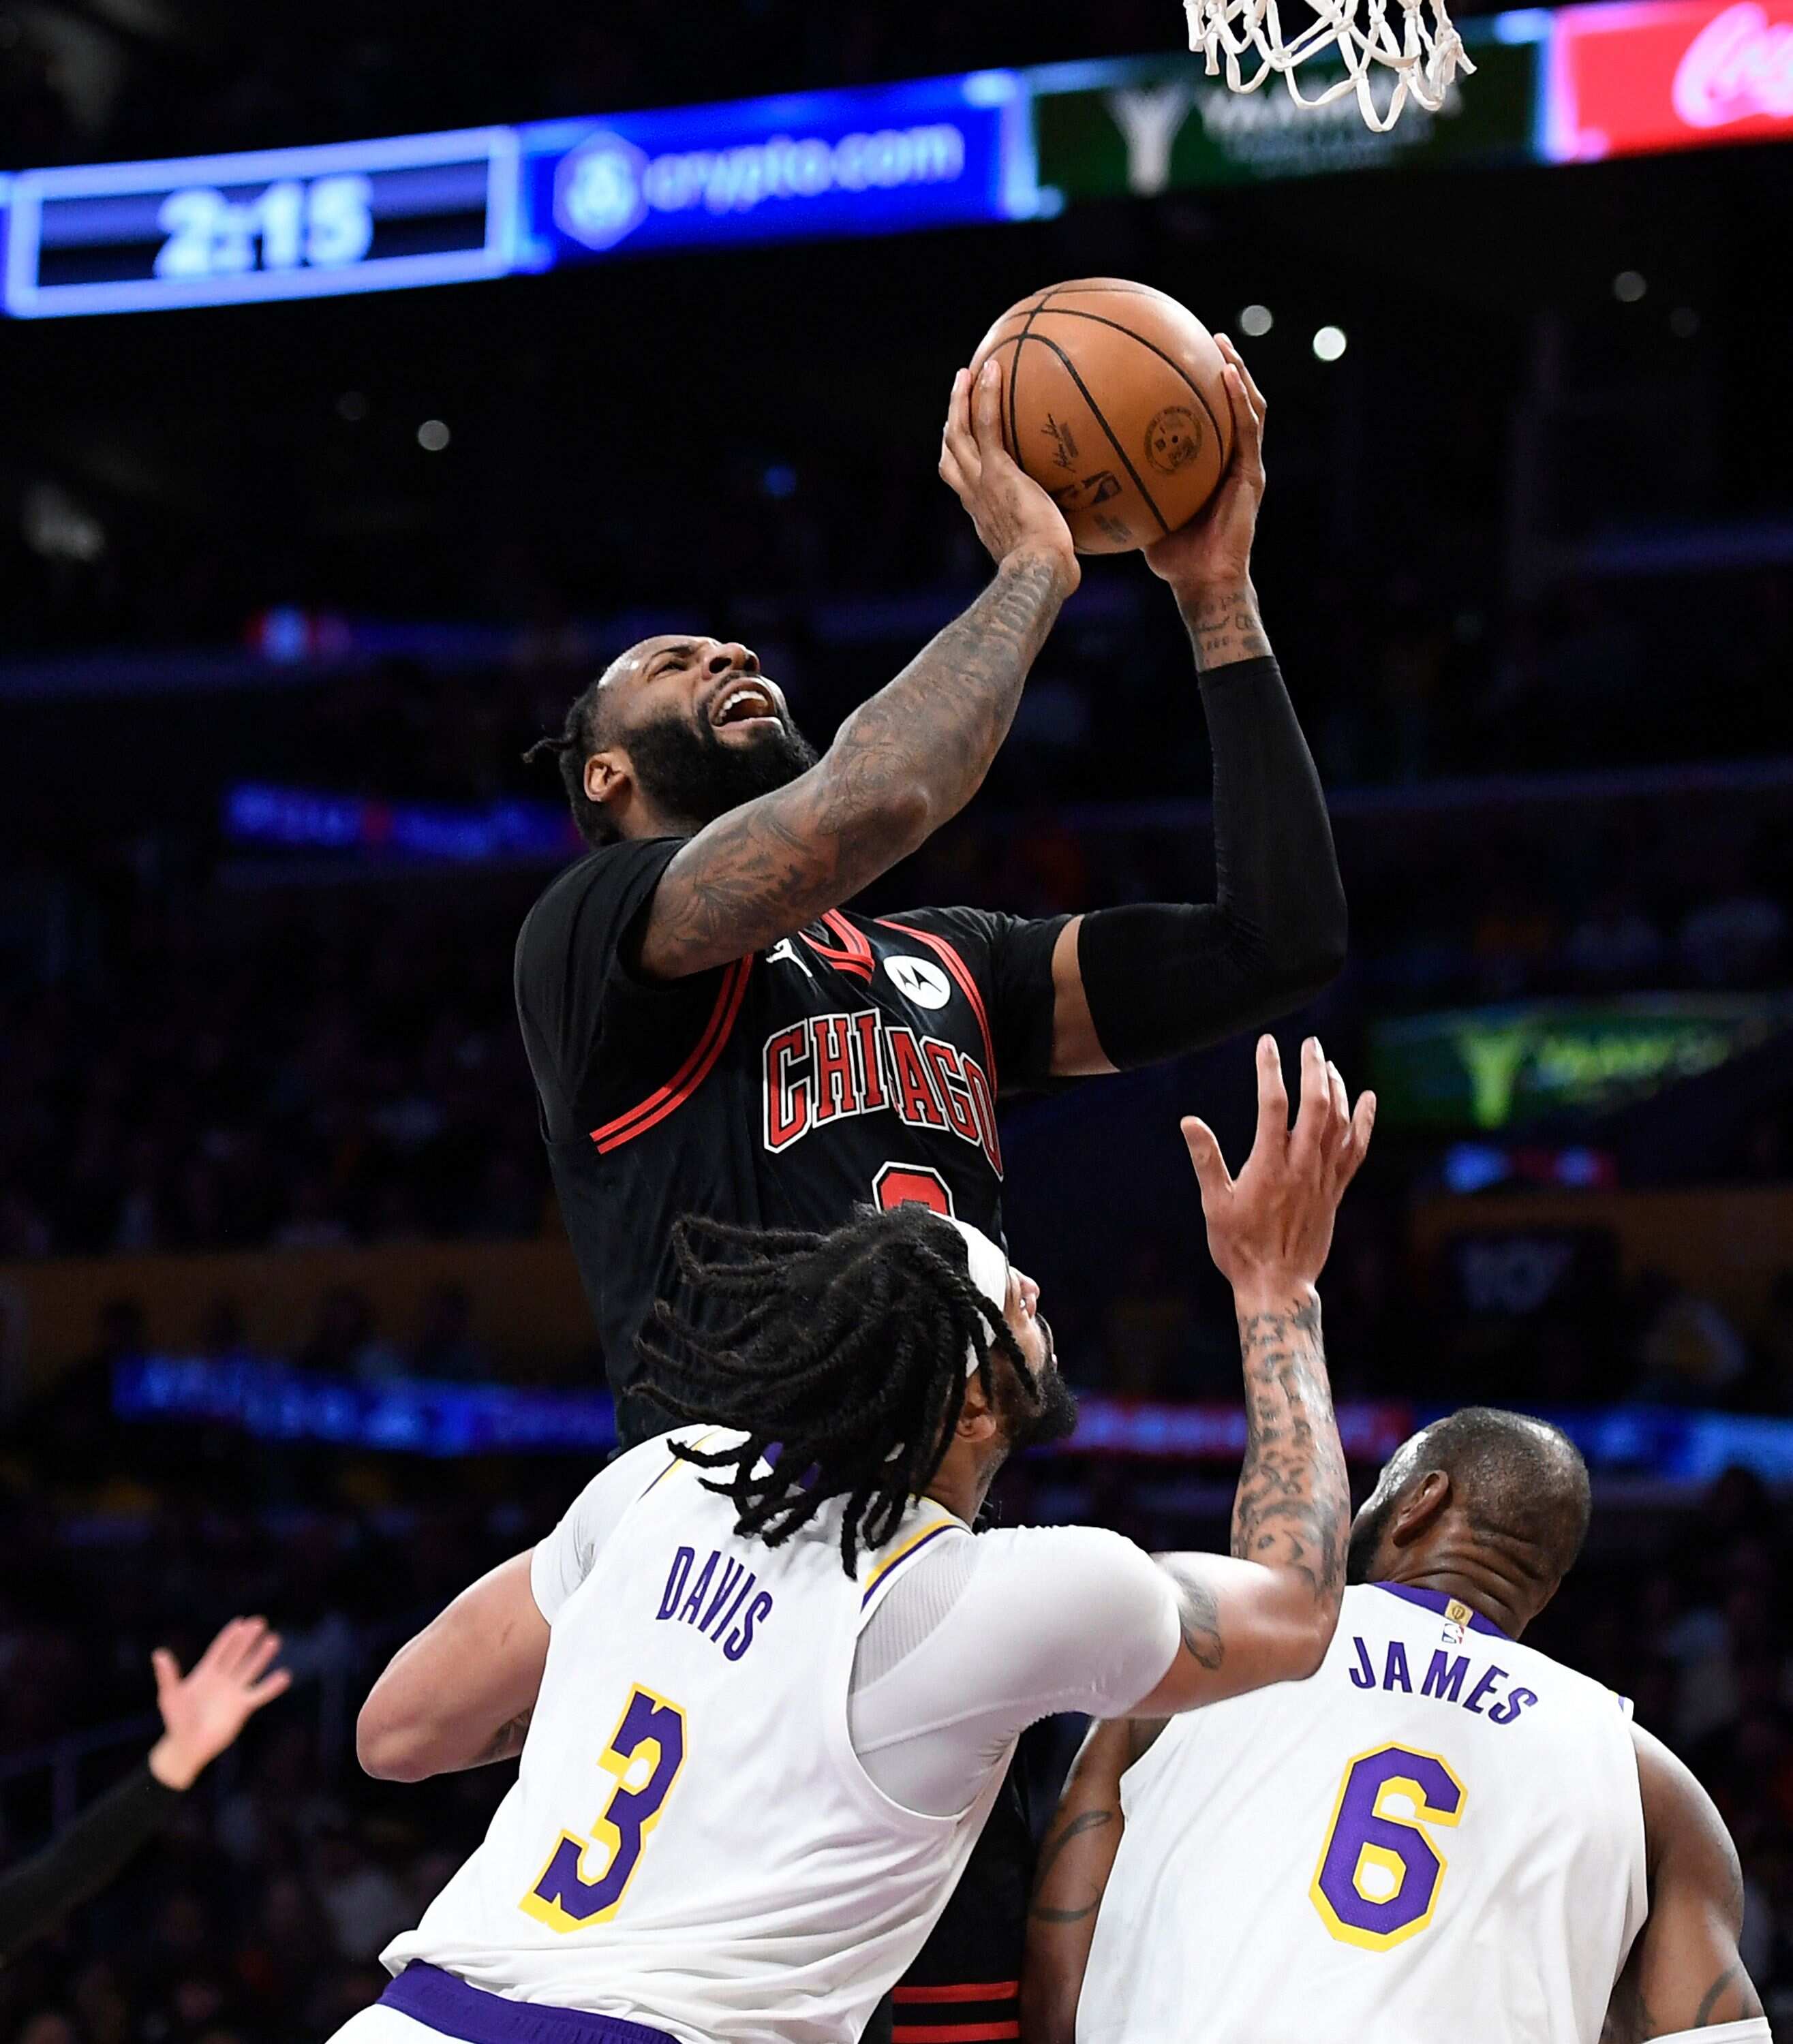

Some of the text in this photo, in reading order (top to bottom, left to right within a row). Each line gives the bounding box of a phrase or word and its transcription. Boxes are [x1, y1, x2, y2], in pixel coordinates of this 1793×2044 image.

[154, 173, 373, 278] 2:15
[643, 125, 965, 213] crypto.com
[763, 1008, 1004, 1182] CHIAGO
[656, 1546, 773, 1661] DAVIS
[1349, 1636, 1539, 1725] JAMES
[518, 1682, 687, 1934] 3
[1308, 1740, 1468, 1953] 6
